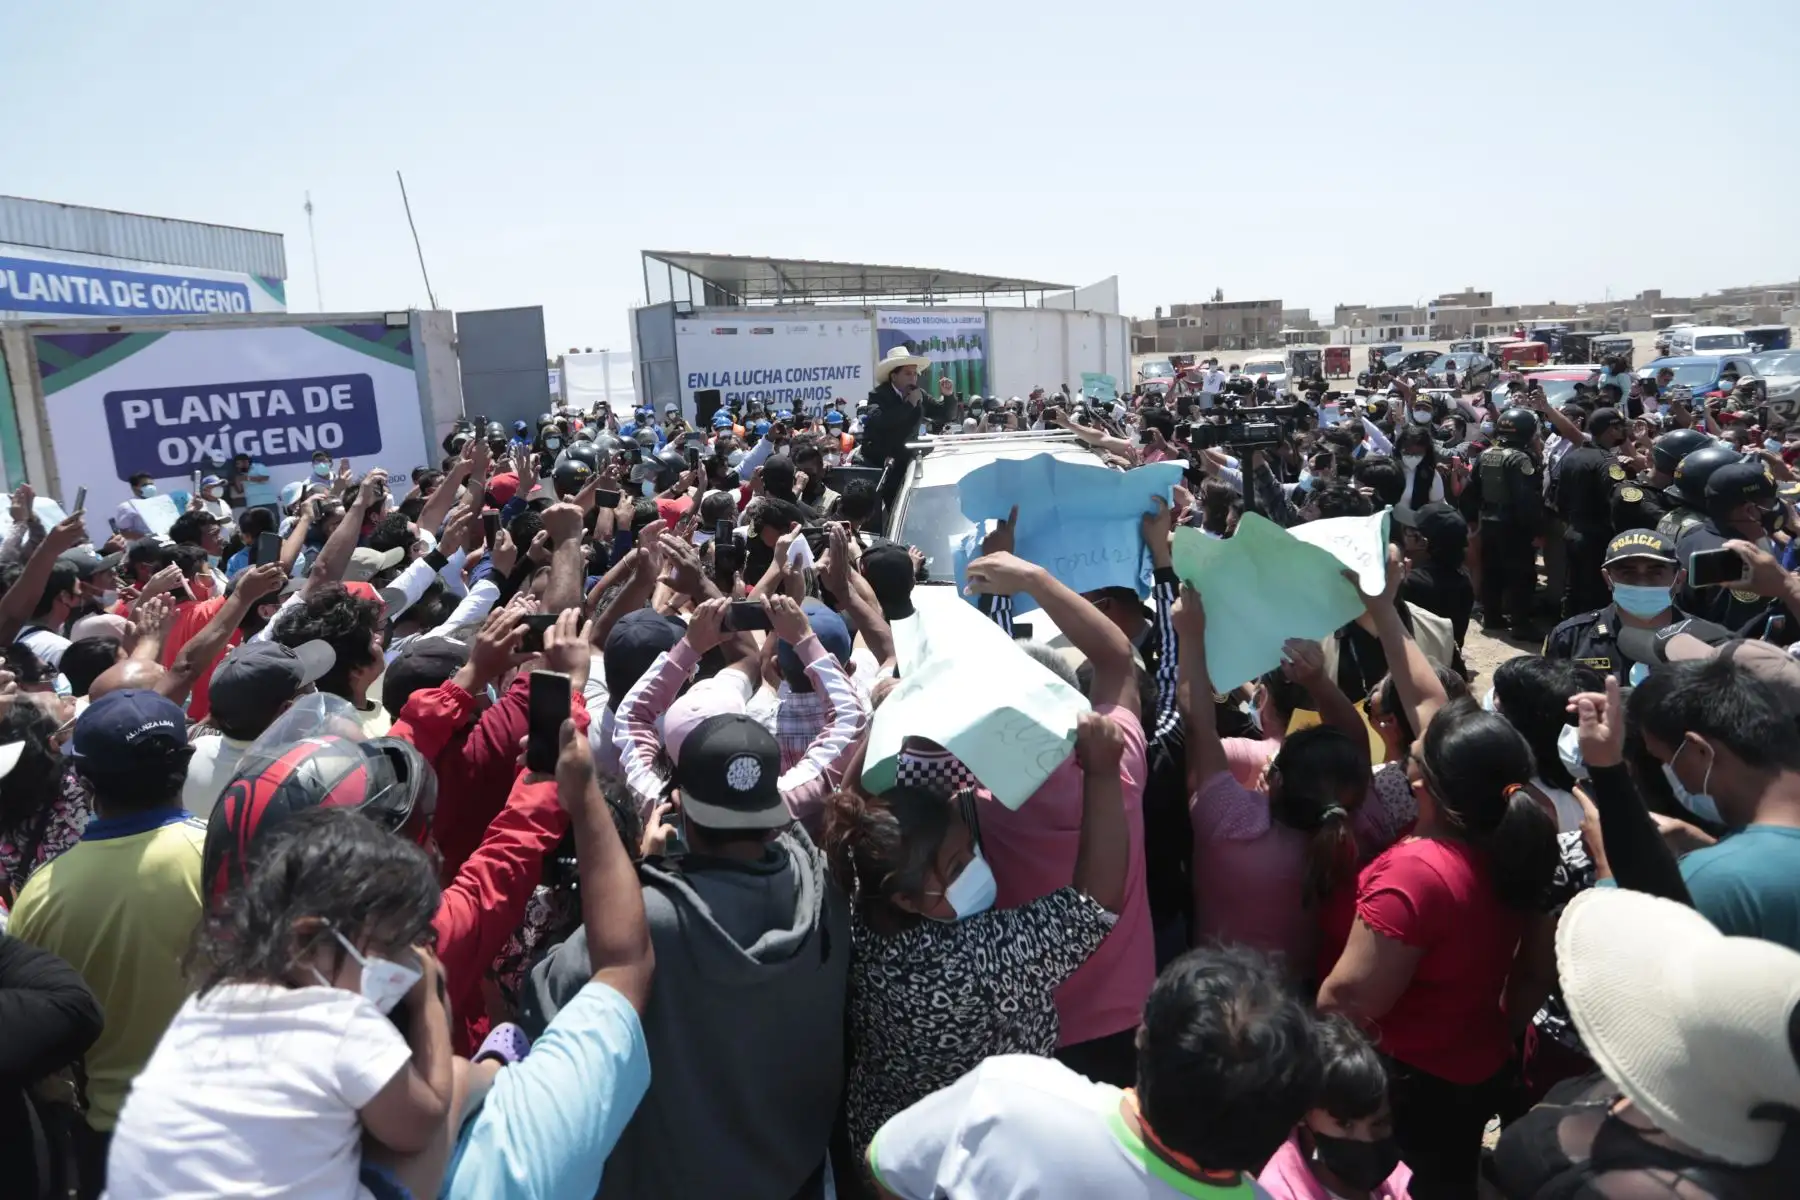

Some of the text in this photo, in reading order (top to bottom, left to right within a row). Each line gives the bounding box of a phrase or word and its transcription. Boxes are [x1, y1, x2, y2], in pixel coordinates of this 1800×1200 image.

[109, 280, 149, 308] DE
[152, 280, 245, 313] OXÍGENO
[688, 365, 862, 389] EN LA LUCHA CONSTANTE
[121, 384, 354, 429] PLANTA DE
[725, 385, 833, 406] ENCONTRAMOS
[158, 422, 344, 466] OXÍGENO
[1611, 532, 1662, 552] POLICIA
[125, 721, 160, 742] ALIANZA
